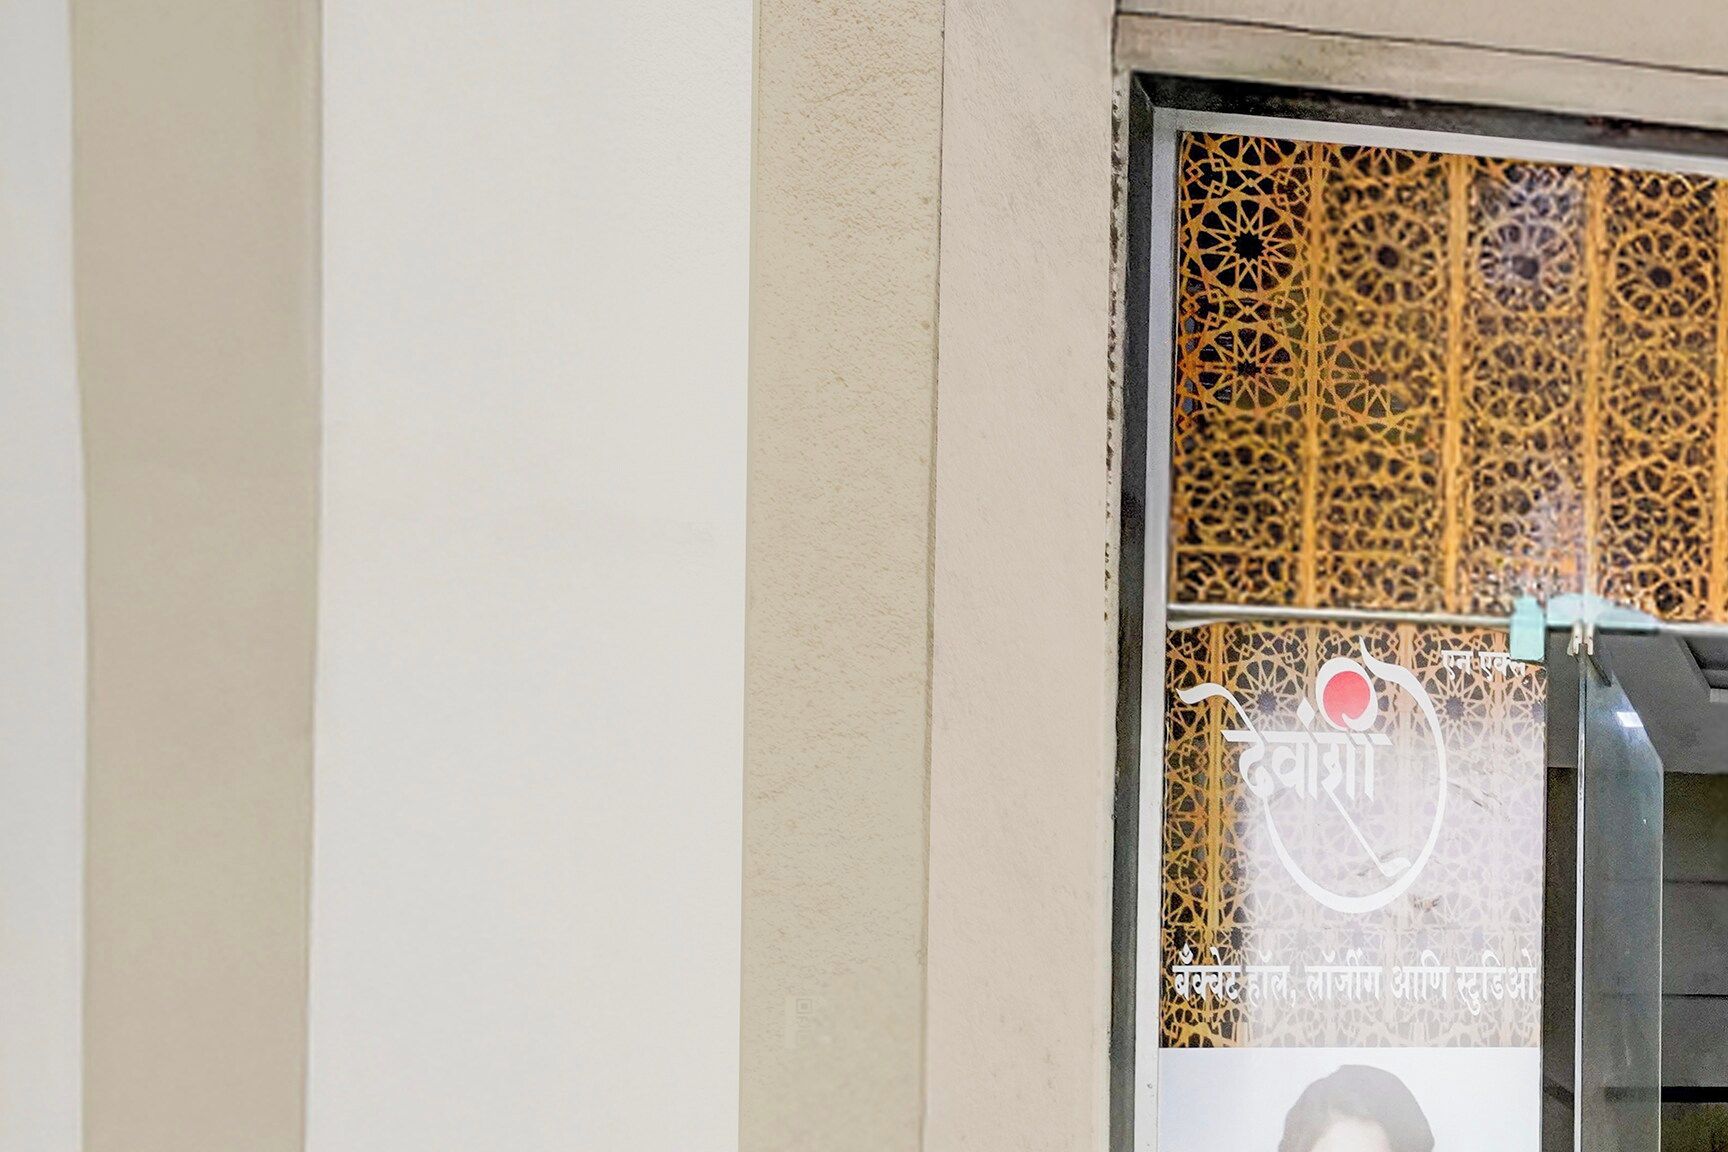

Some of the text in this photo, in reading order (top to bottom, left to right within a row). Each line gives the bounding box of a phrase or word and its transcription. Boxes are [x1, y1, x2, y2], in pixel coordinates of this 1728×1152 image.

[1441, 650, 1474, 680] एन
[1246, 950, 1296, 1008] हॉल,
[1391, 949, 1450, 1001] आणि
[1455, 948, 1537, 1015] स्टुडिओ
